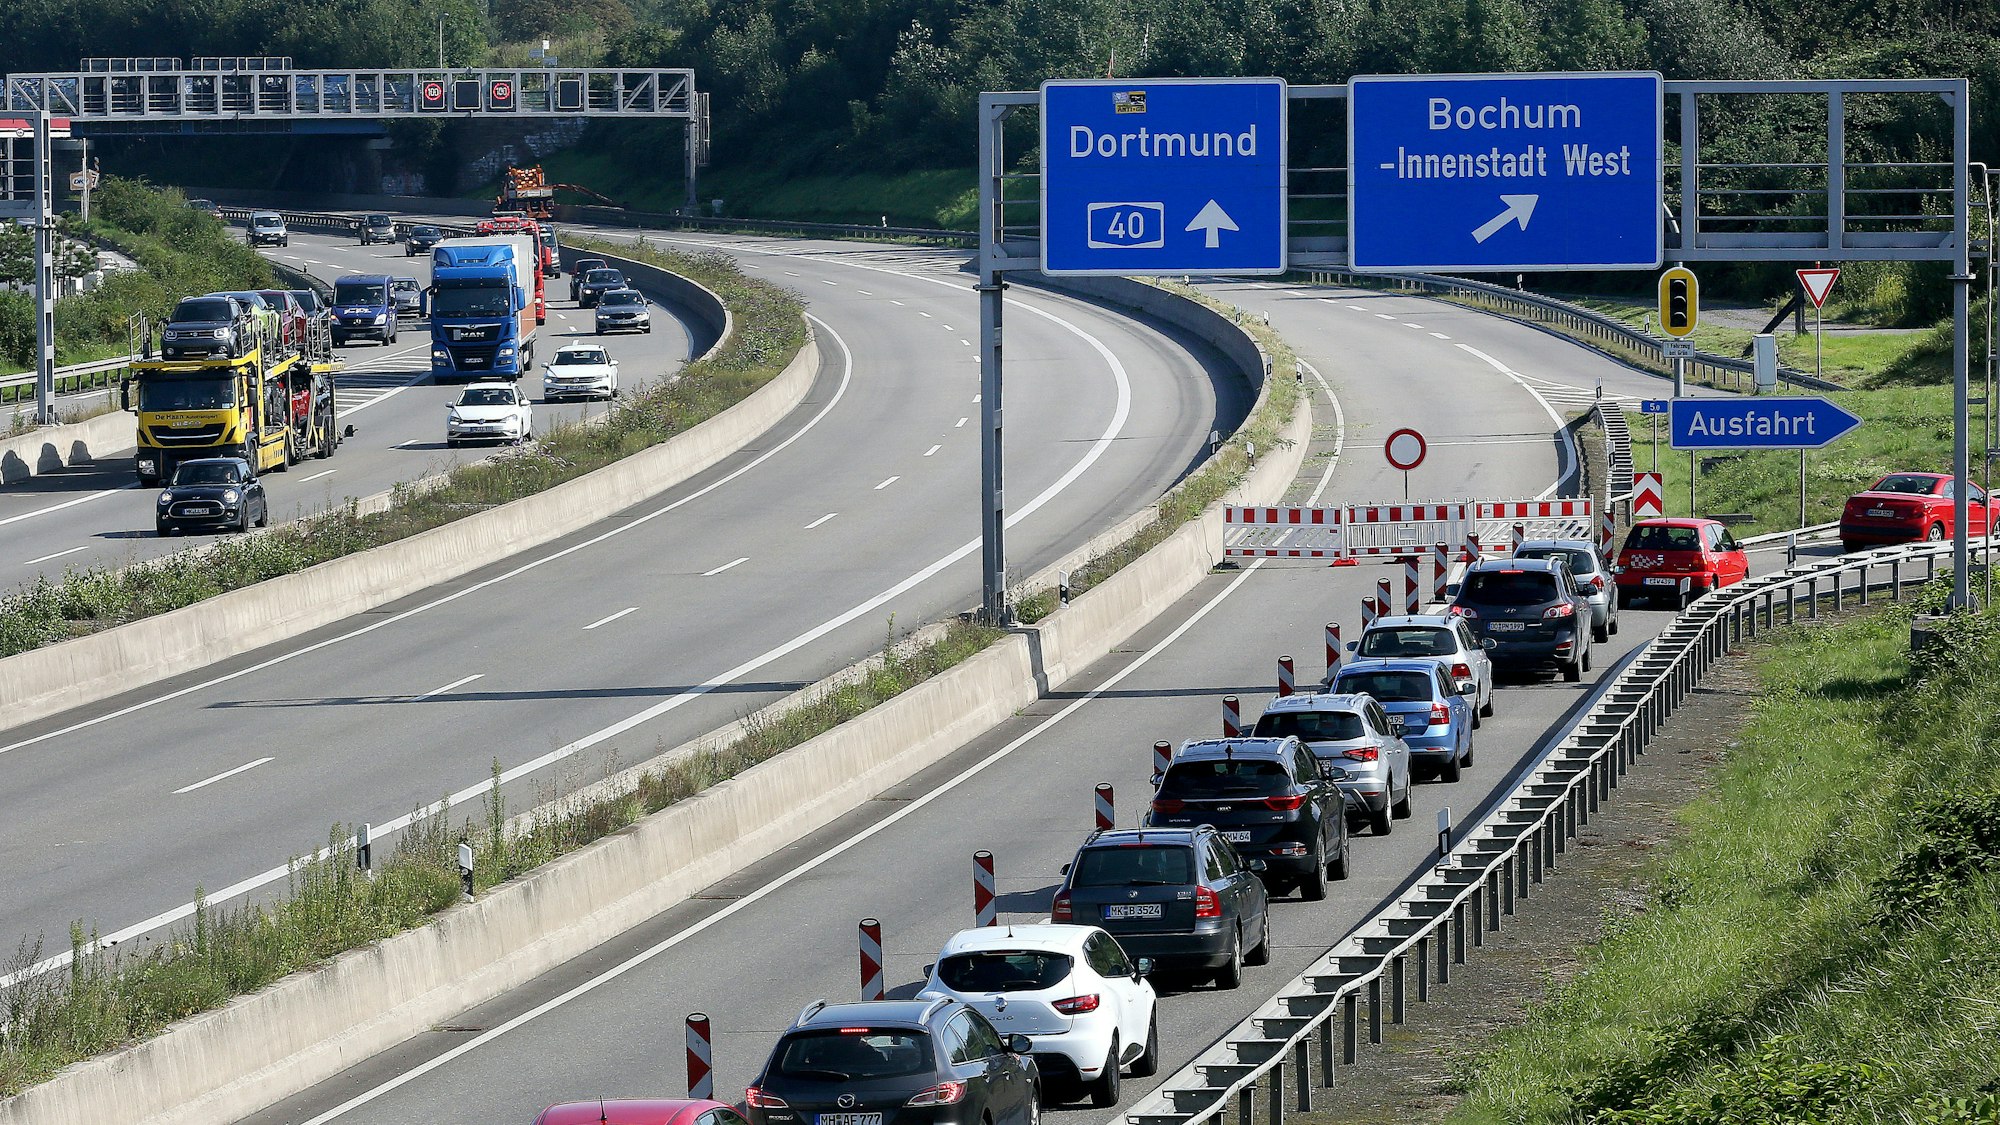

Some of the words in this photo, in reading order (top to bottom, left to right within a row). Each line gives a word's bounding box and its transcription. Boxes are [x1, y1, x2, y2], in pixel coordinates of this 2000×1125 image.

[428, 88, 439, 96] 100
[496, 87, 507, 96] 100
[1429, 97, 1581, 130] Bochum
[1070, 124, 1256, 158] Dortmund
[1380, 145, 1547, 179] -Innenstadt
[1562, 143, 1631, 176] West
[1107, 211, 1144, 239] 40
[1687, 410, 1815, 436] Ausfahrt
[1111, 906, 1123, 915] MK
[1137, 905, 1160, 915] 3524
[859, 1113, 881, 1125] 777
